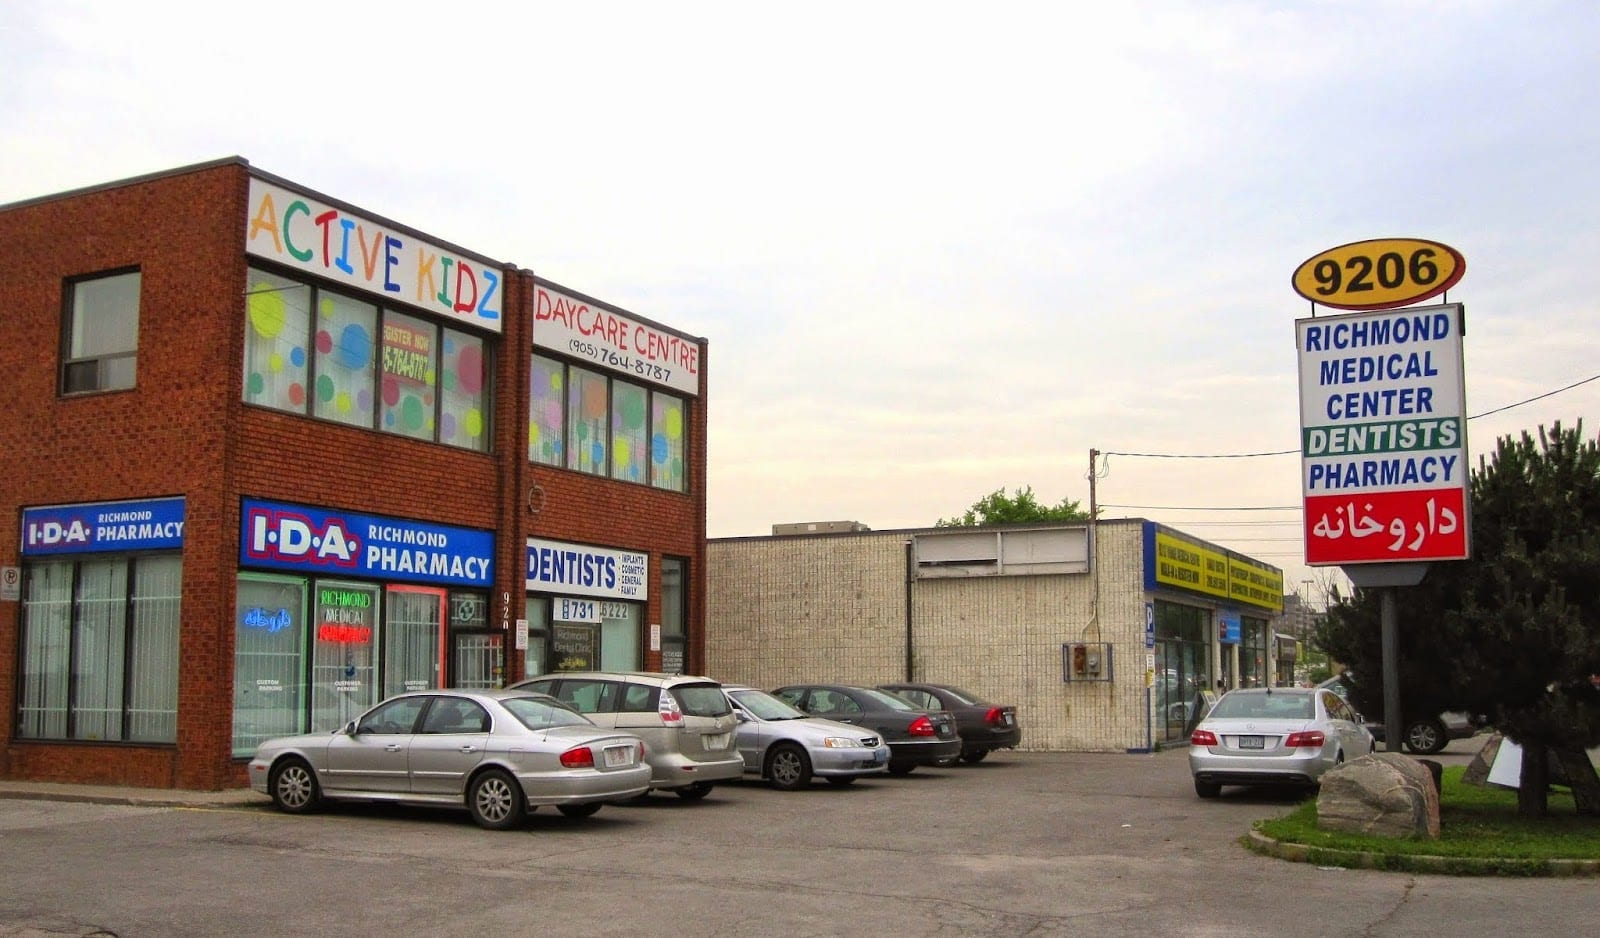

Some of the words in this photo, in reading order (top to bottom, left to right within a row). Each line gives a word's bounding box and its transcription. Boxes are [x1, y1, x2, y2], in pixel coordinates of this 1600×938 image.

[250, 193, 402, 292] ACTIVE
[417, 248, 499, 320] KIDZ
[1313, 248, 1438, 296] 9206
[535, 289, 628, 351] DAYCARE
[634, 325, 698, 375] CENTRE
[1305, 313, 1449, 352] RICHMOND
[569, 338, 598, 359] (905)
[600, 348, 671, 382] 764-8787
[1320, 351, 1438, 385] MEDICAL
[1326, 387, 1433, 420] CENTER
[1308, 419, 1457, 454] DENTISTS
[1309, 455, 1457, 490] PHARMACY
[96, 521, 184, 541] PHARMACY
[98, 511, 152, 523] RICHMOND
[1312, 497, 1457, 551] داروخانه
[368, 525, 447, 548] RICHMOND
[366, 545, 490, 580] PHARMACY
[526, 546, 616, 589] DENTISTS
[321, 590, 370, 608] RICHMOND
[326, 608, 364, 625] MEDICAL
[572, 601, 593, 619] 731
[602, 602, 627, 618] 6222
